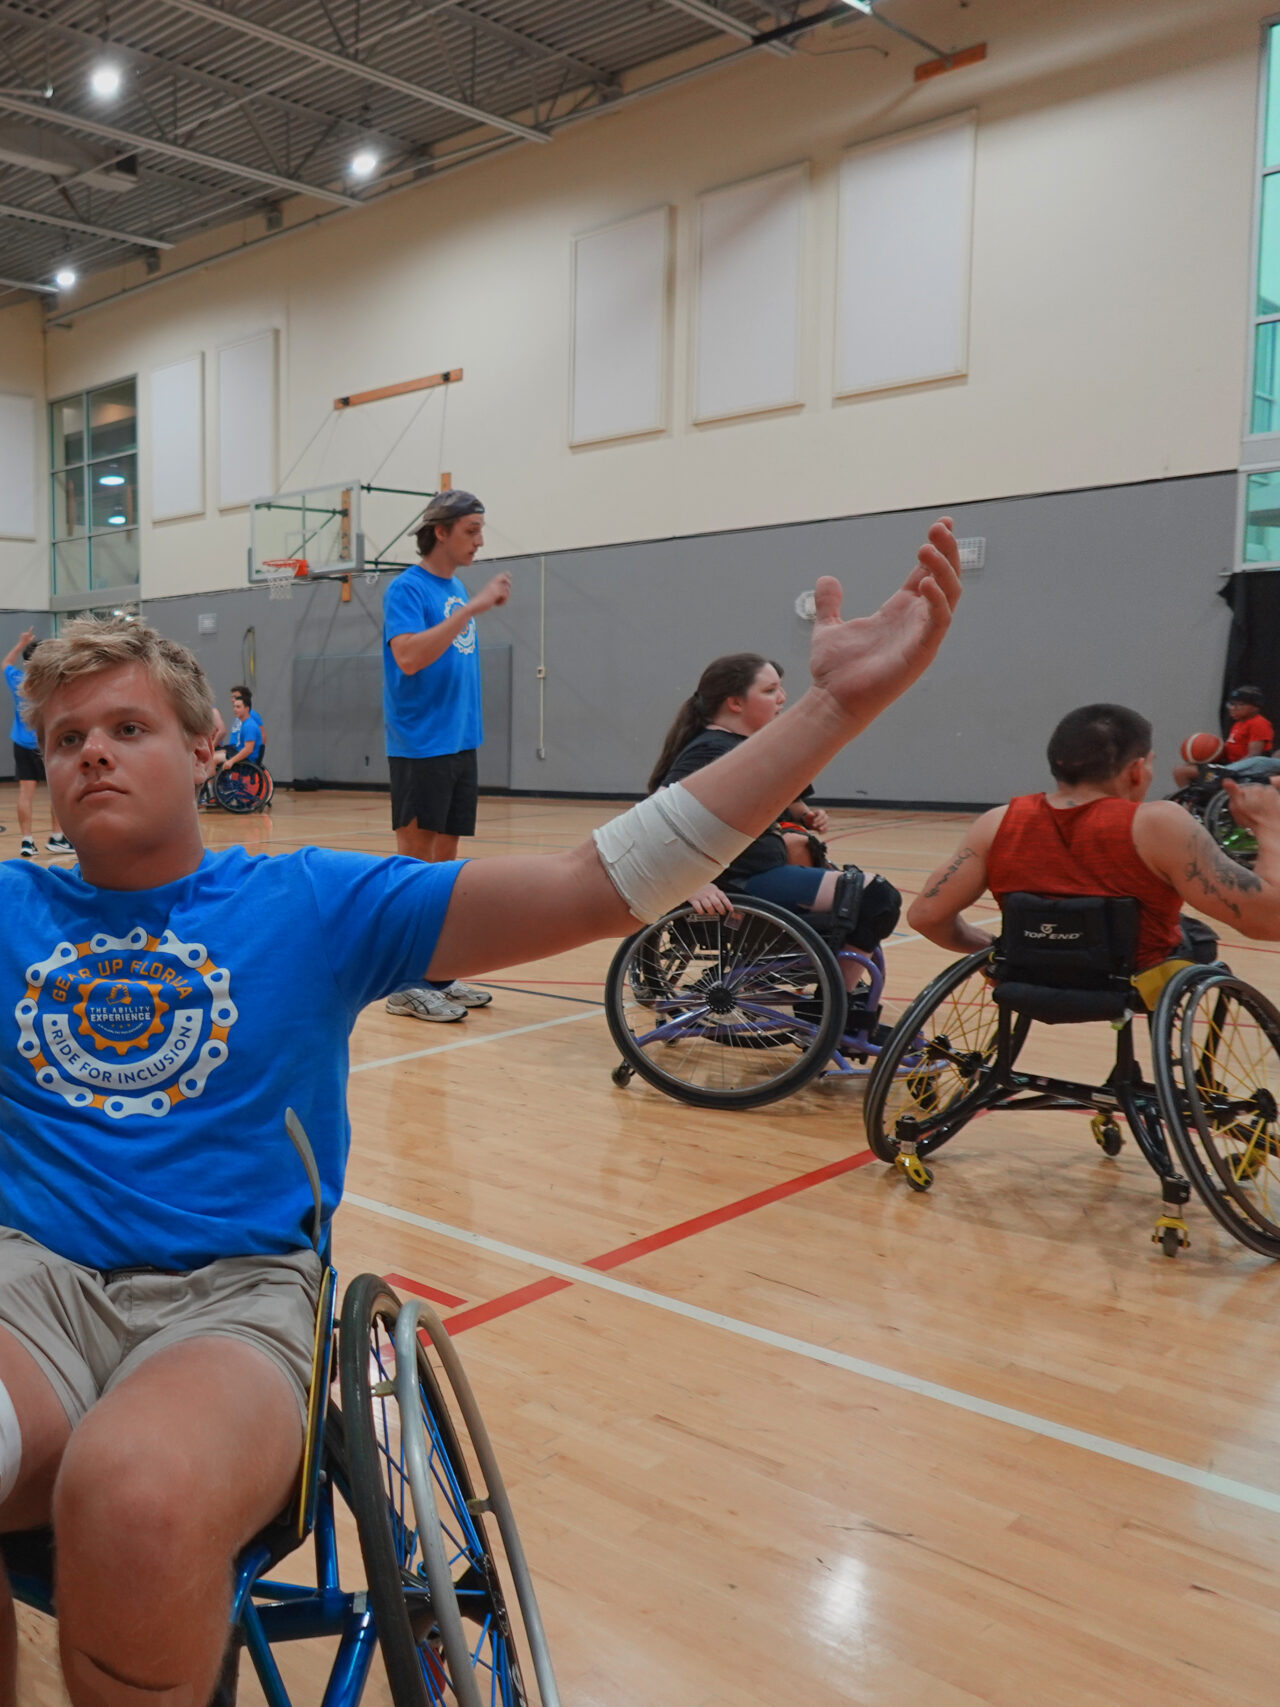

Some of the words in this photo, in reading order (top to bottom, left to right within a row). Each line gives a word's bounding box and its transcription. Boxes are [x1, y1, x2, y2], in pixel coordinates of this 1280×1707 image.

[1024, 930, 1046, 939] TOP
[98, 959, 123, 976] UP
[90, 1012, 151, 1022] EXPERIENCE
[51, 1028, 81, 1065] RIDE
[79, 1061, 113, 1083] FOR
[118, 1025, 193, 1084] INCLUSION
